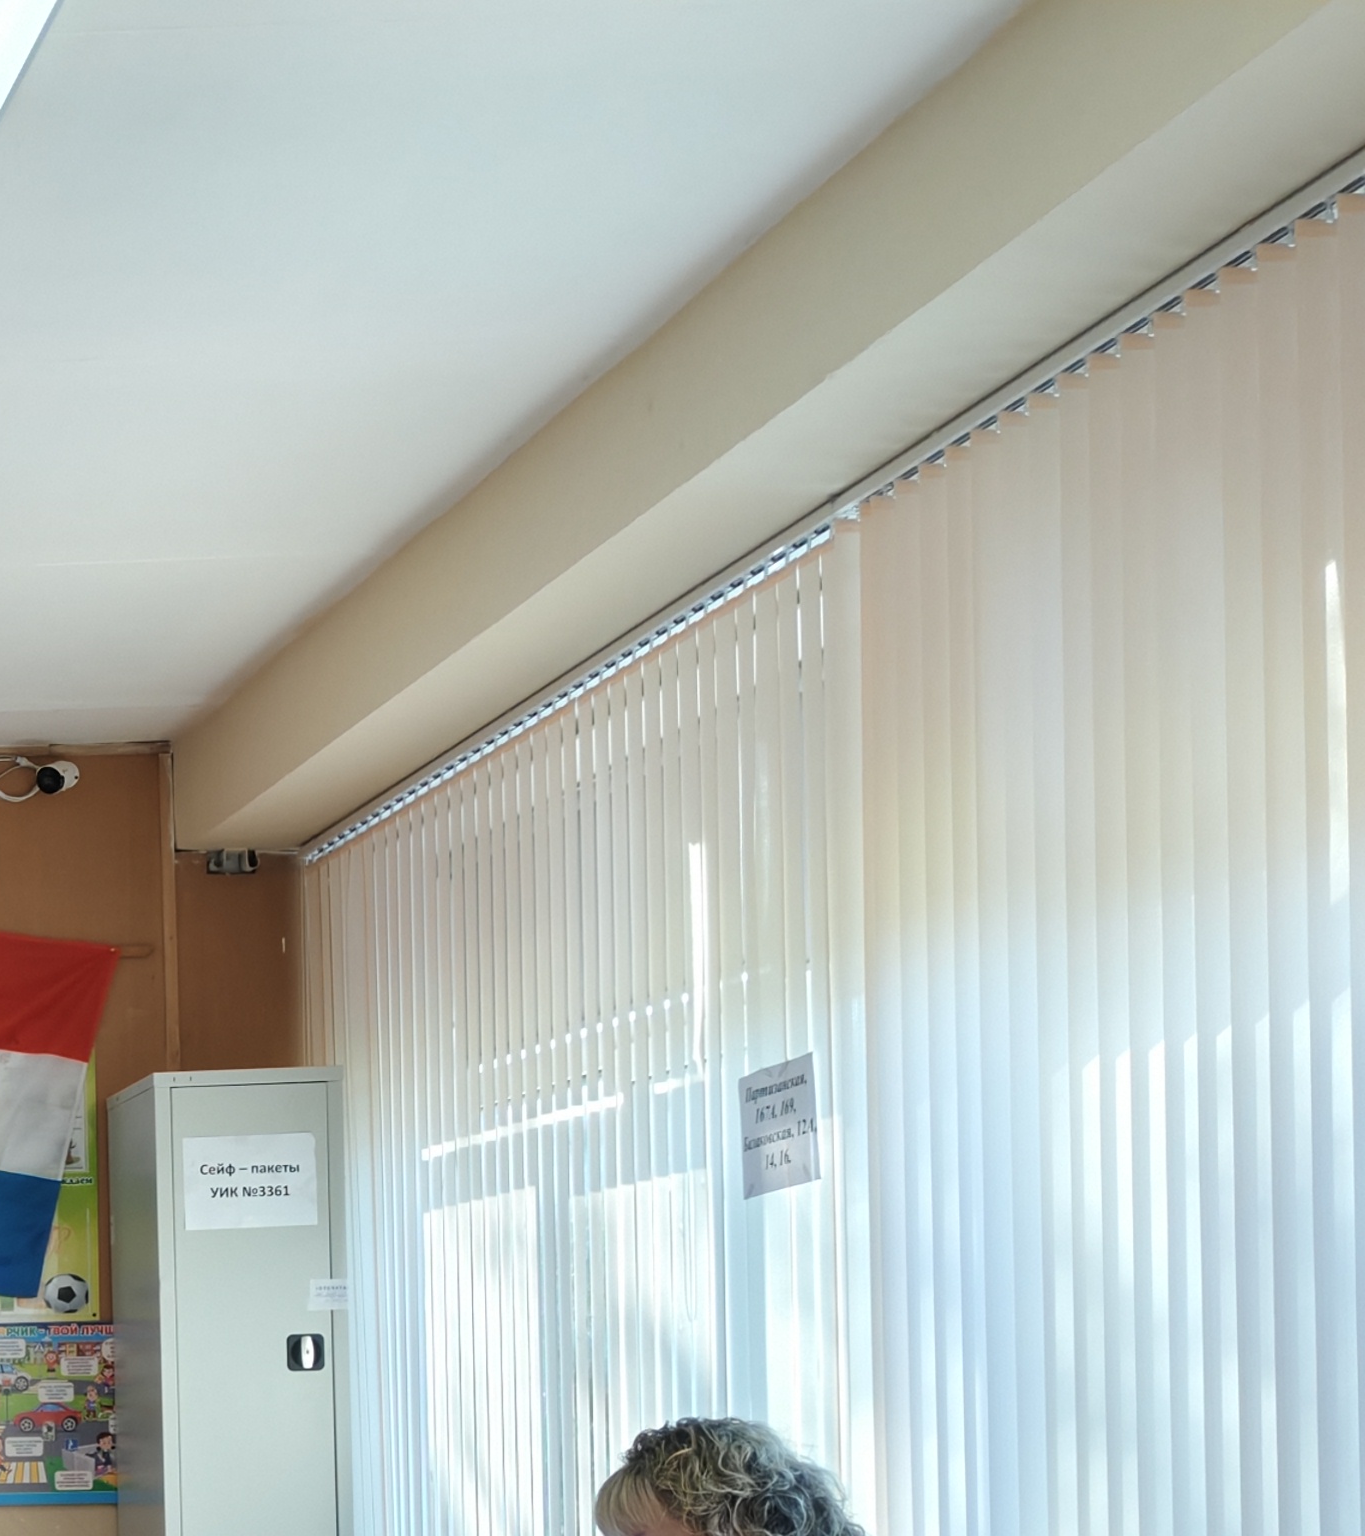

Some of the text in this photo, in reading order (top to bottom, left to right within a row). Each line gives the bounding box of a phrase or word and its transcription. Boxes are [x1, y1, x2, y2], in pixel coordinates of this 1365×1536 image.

[200, 1163, 236, 1176] Сейф
[251, 1163, 300, 1174] пакеты
[210, 1185, 290, 1198] УИК №3361
[47, 1323, 79, 1336] ТВОЙ
